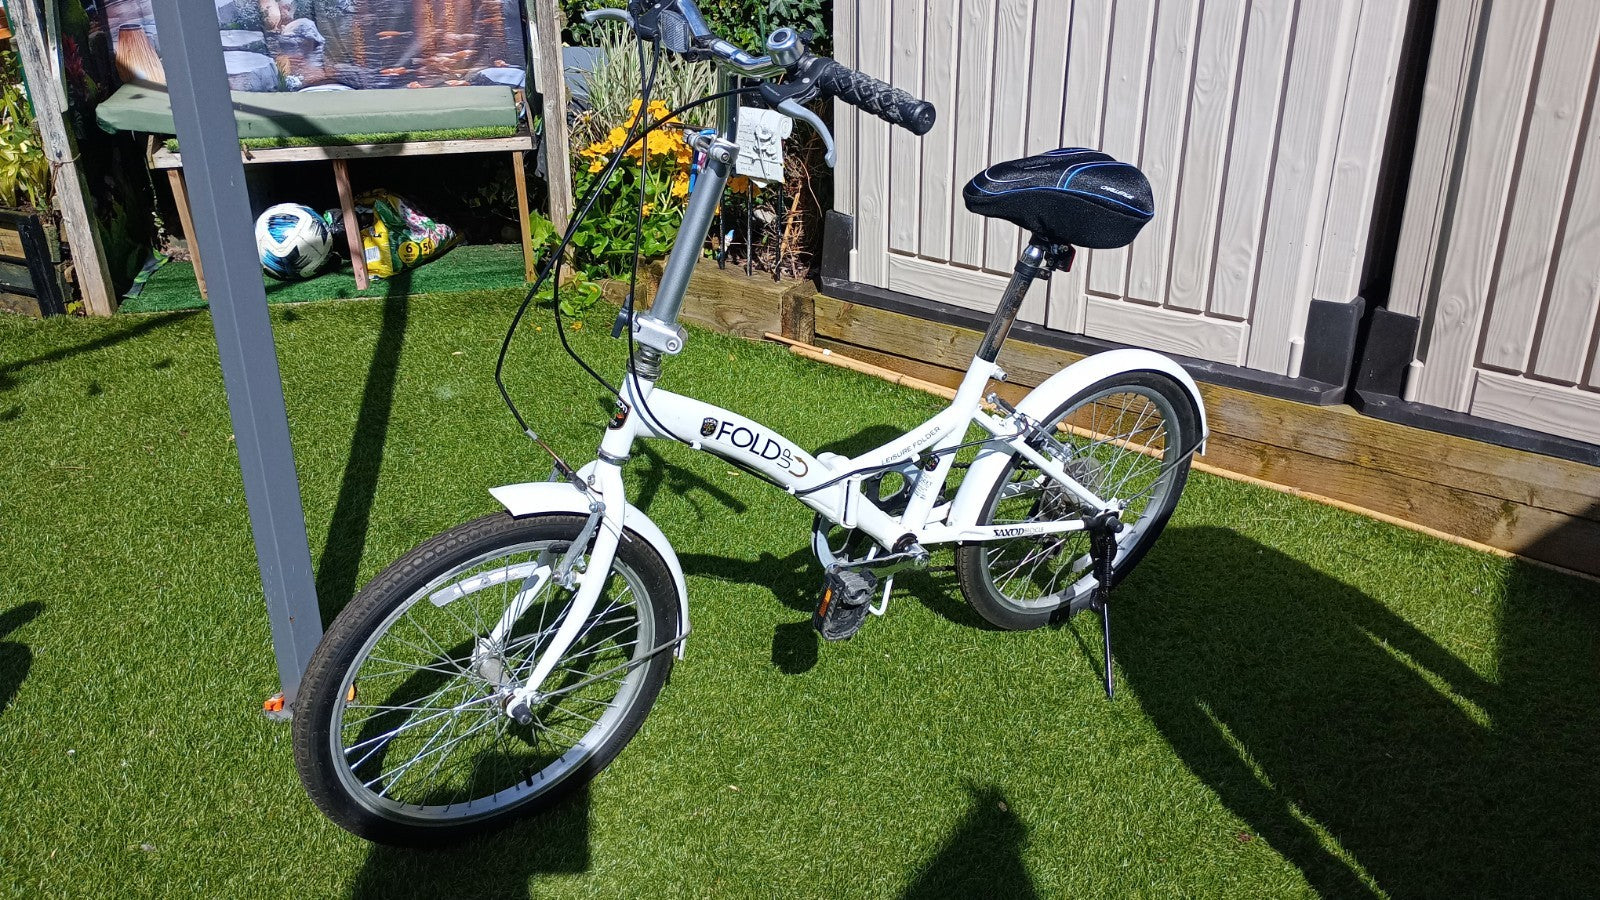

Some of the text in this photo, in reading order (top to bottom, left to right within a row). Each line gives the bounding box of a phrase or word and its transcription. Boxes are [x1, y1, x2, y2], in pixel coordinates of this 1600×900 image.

[405, 243, 413, 253] 6
[715, 421, 793, 469] FOLD UP
[881, 426, 940, 466] LEISURE FOLDER
